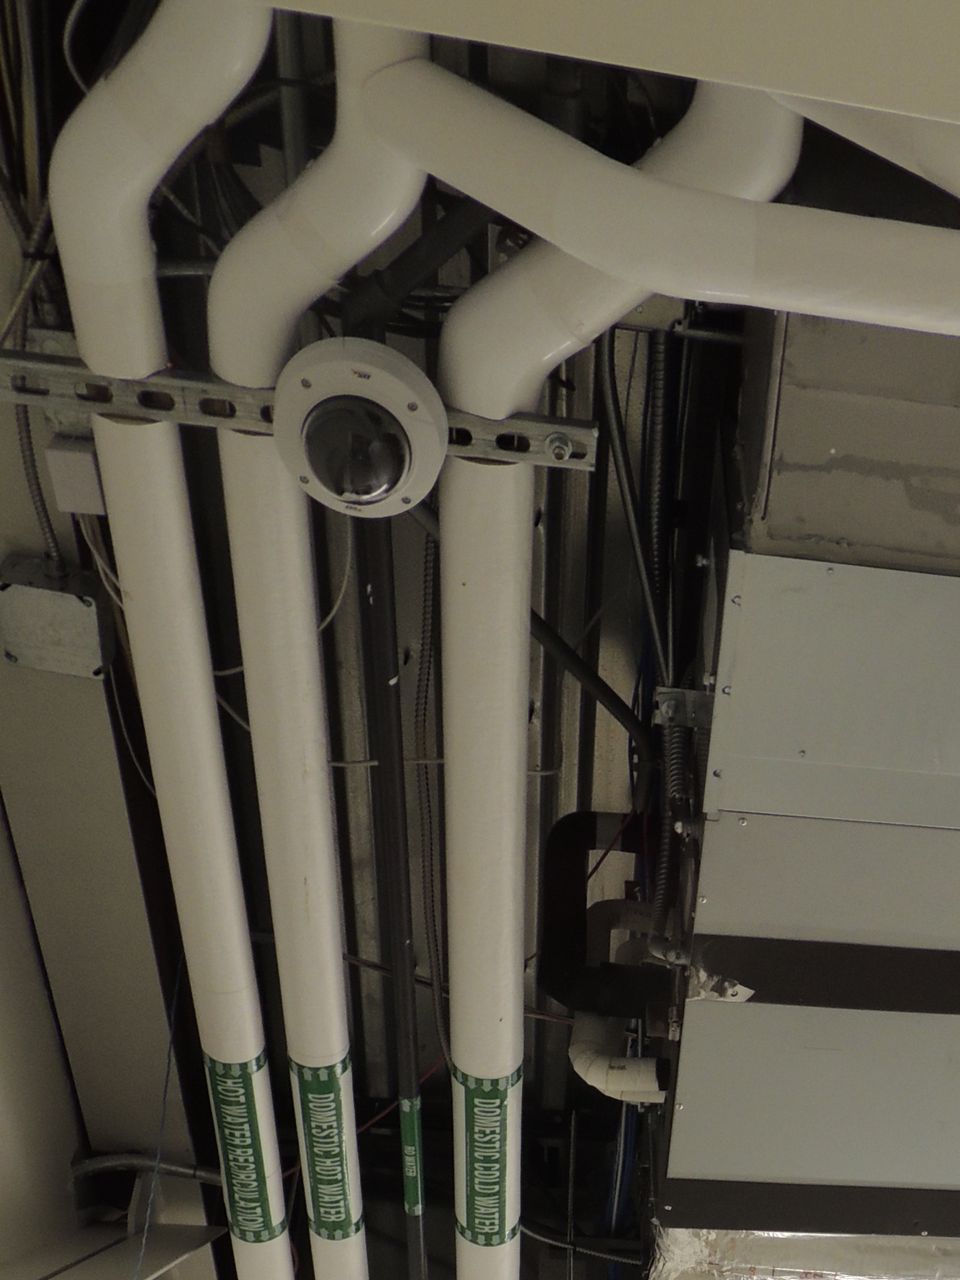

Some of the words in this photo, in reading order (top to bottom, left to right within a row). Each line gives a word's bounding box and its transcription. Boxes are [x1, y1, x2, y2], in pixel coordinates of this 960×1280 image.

[216, 1076, 246, 1103] HOT
[220, 1104, 252, 1146] WATER
[308, 1093, 340, 1155] DOMESTIC
[474, 1098, 500, 1160] DOMESTIC
[227, 1145, 265, 1232] RECIRCULATION
[315, 1157, 343, 1181] HOT
[474, 1163, 500, 1193] COLD
[318, 1182, 346, 1222] WATER
[474, 1195, 500, 1233] WATER
